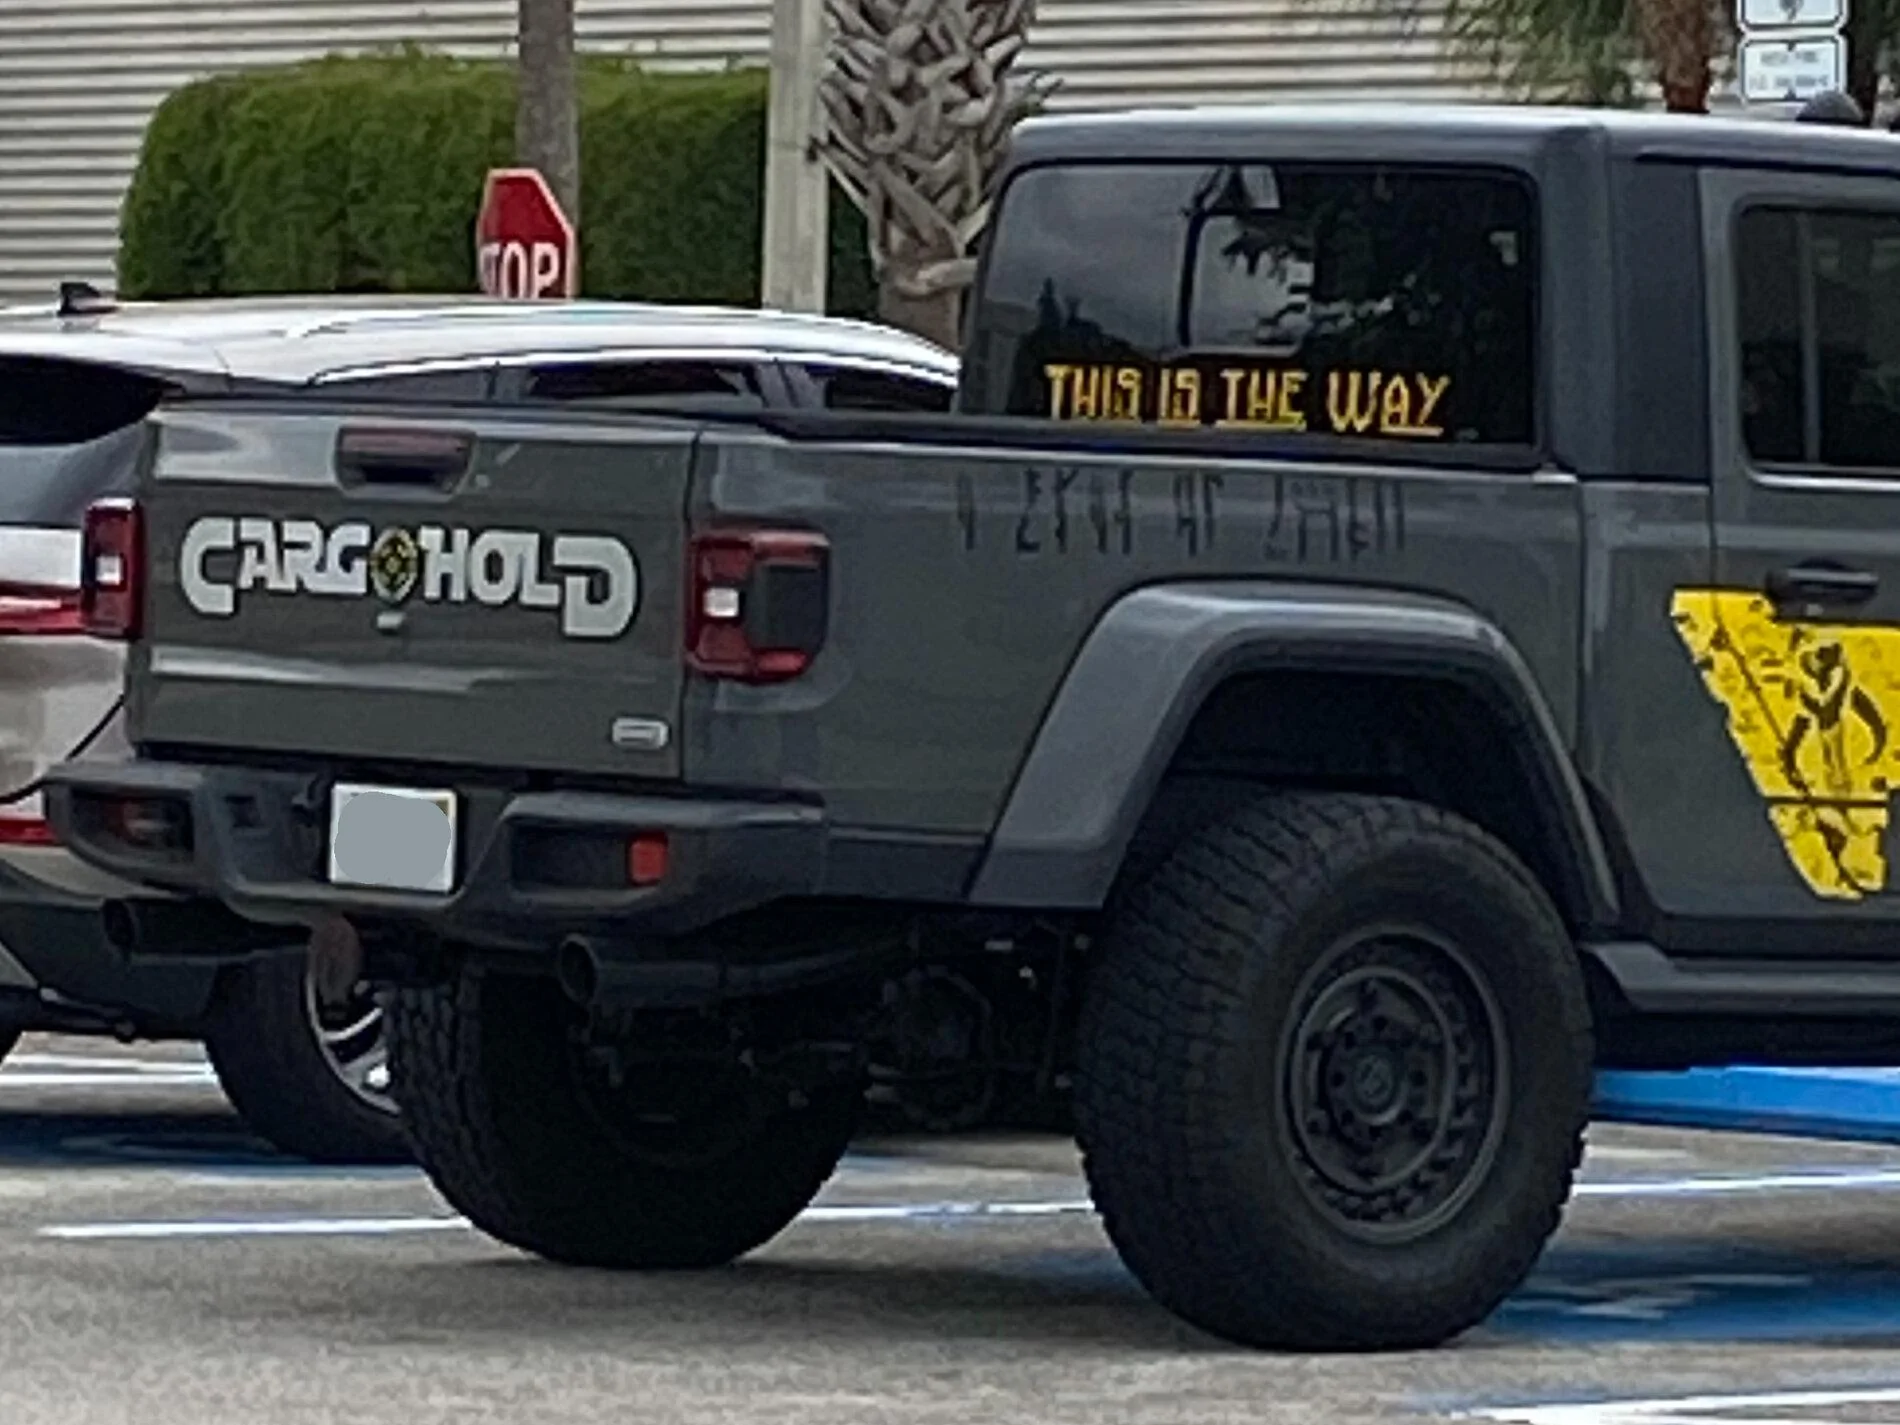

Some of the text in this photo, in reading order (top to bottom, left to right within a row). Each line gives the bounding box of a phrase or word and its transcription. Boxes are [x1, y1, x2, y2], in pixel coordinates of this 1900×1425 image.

[479, 242, 560, 298] TOP
[1044, 364, 1451, 437] THIS IS THE WAY
